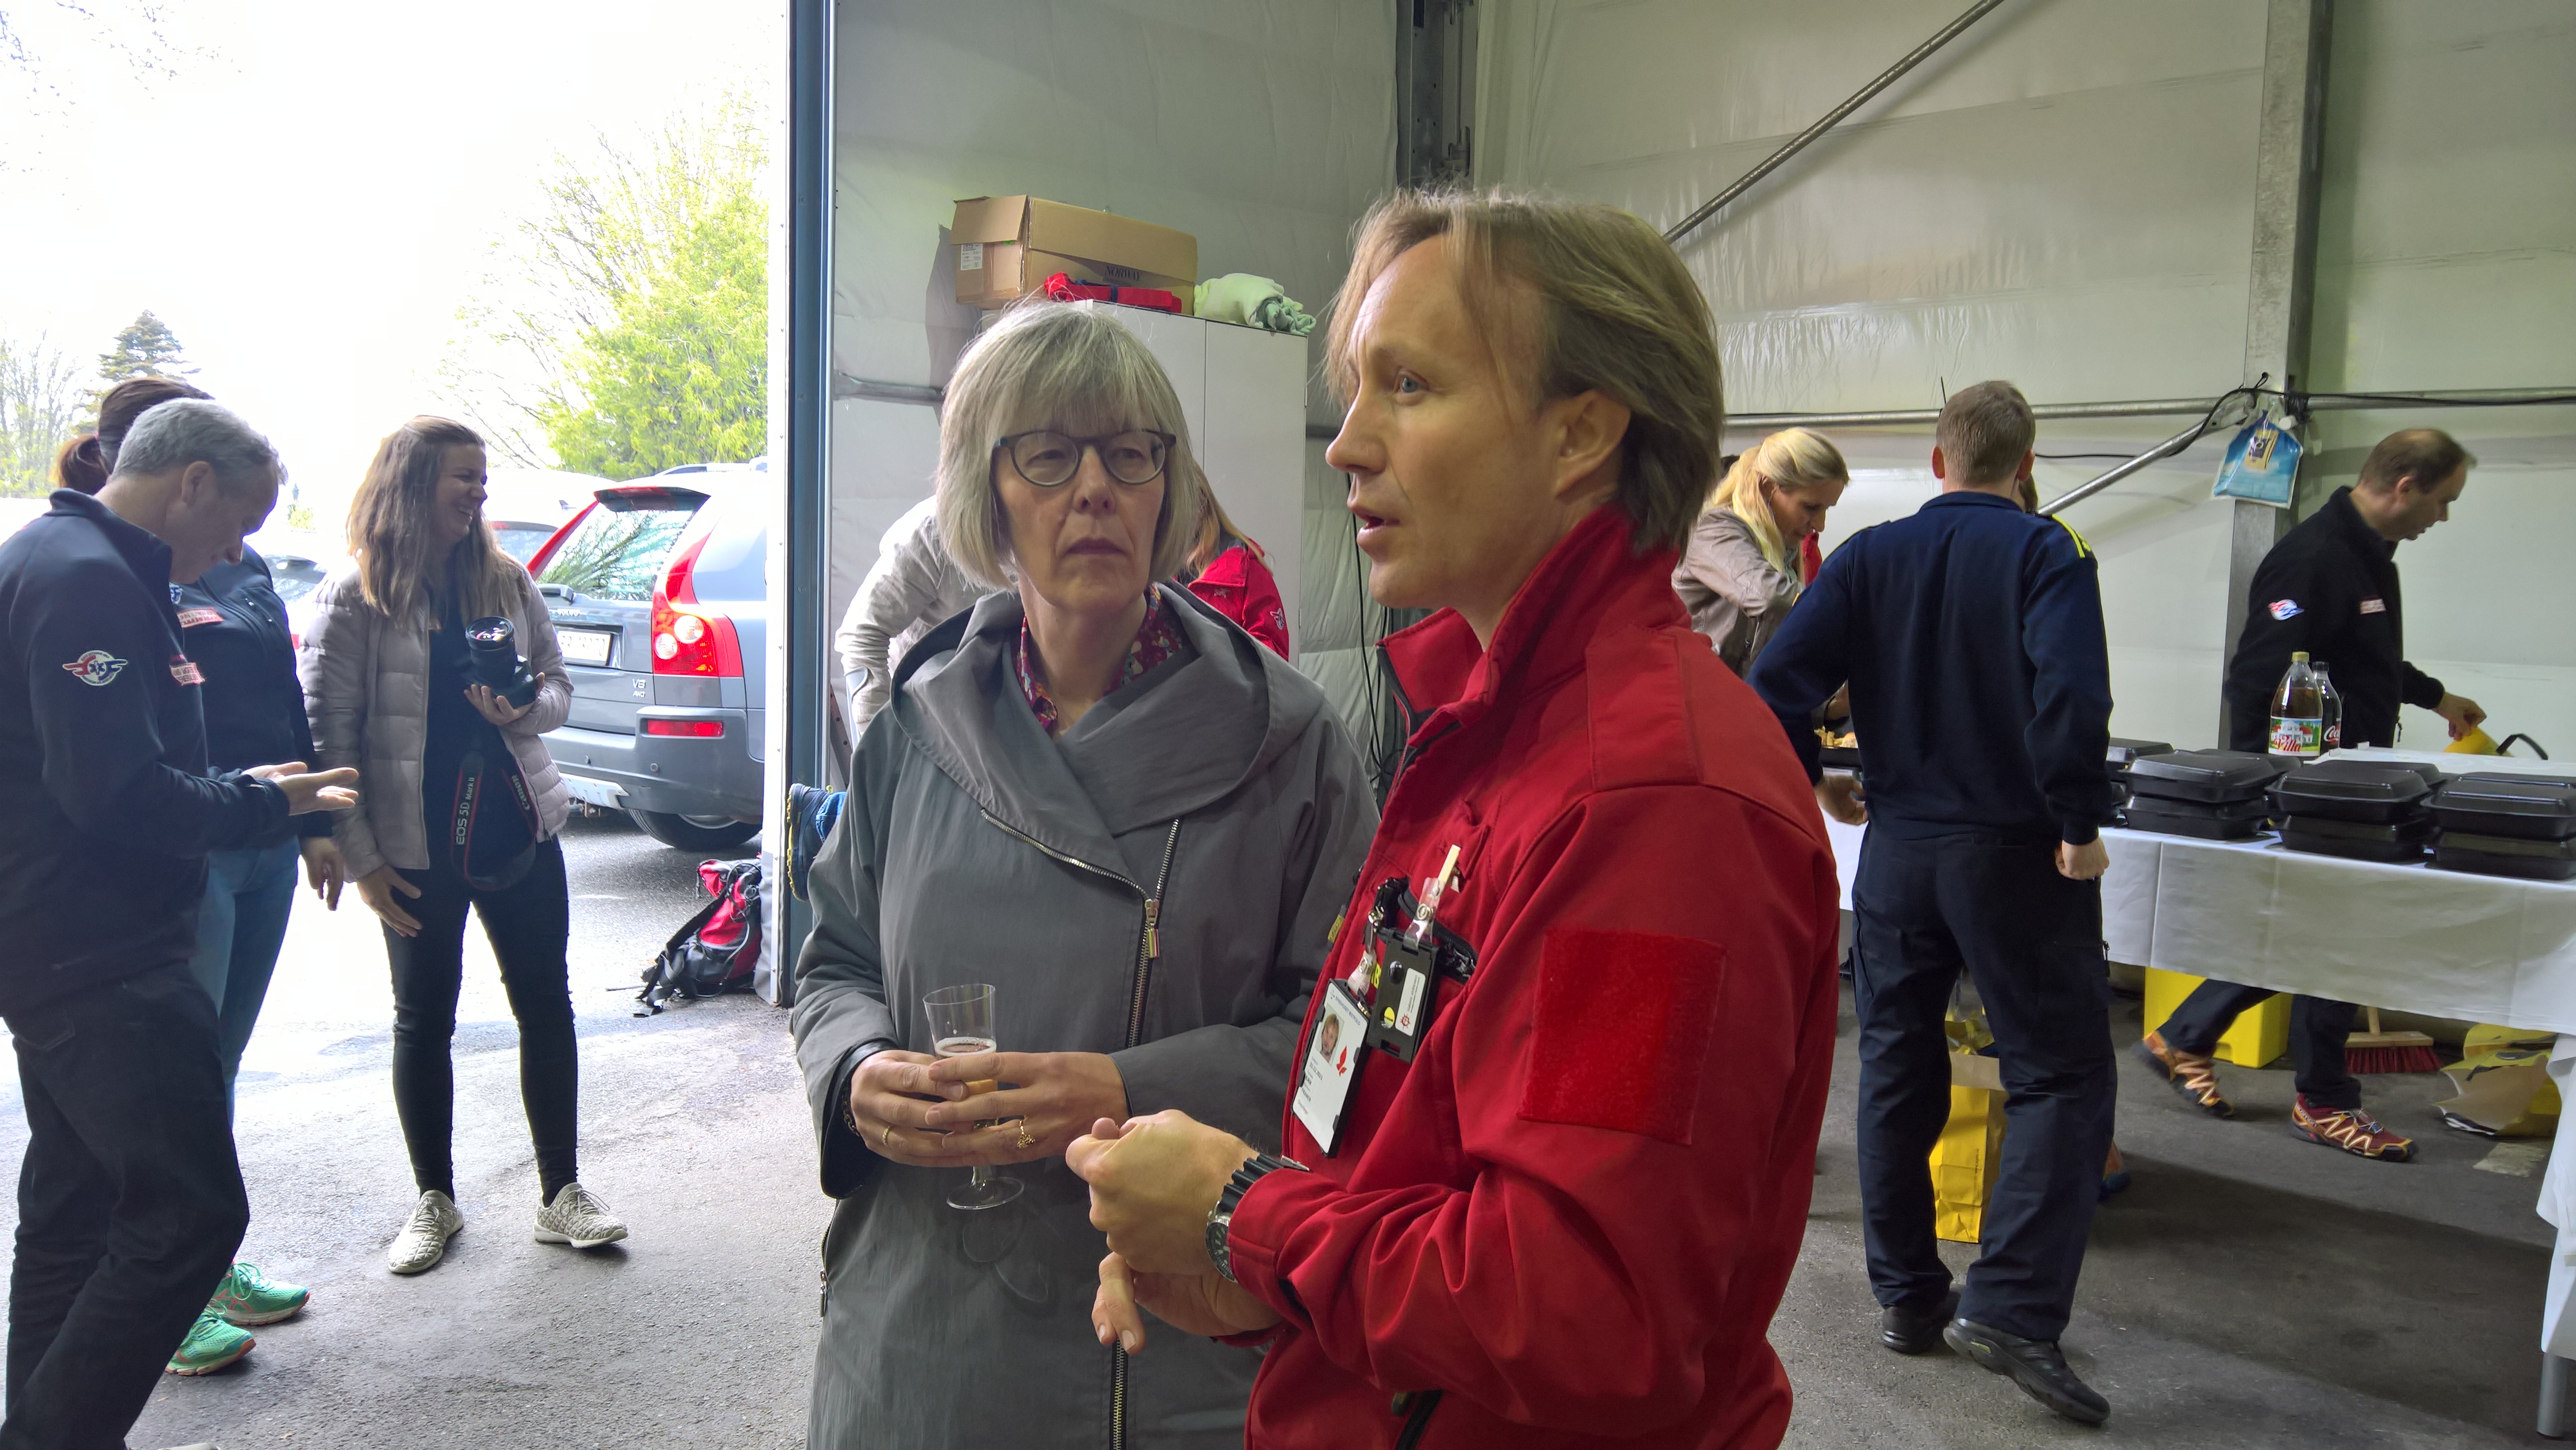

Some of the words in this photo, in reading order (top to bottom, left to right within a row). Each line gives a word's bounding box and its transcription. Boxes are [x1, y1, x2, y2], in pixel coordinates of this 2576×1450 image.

[1106, 265, 1142, 281] NORWAY
[632, 679, 646, 689] V8
[2273, 735, 2302, 752] Villa
[465, 782, 474, 800] Mark
[511, 775, 530, 811] Canon
[459, 802, 470, 816] 5D
[456, 819, 467, 845] EOS
